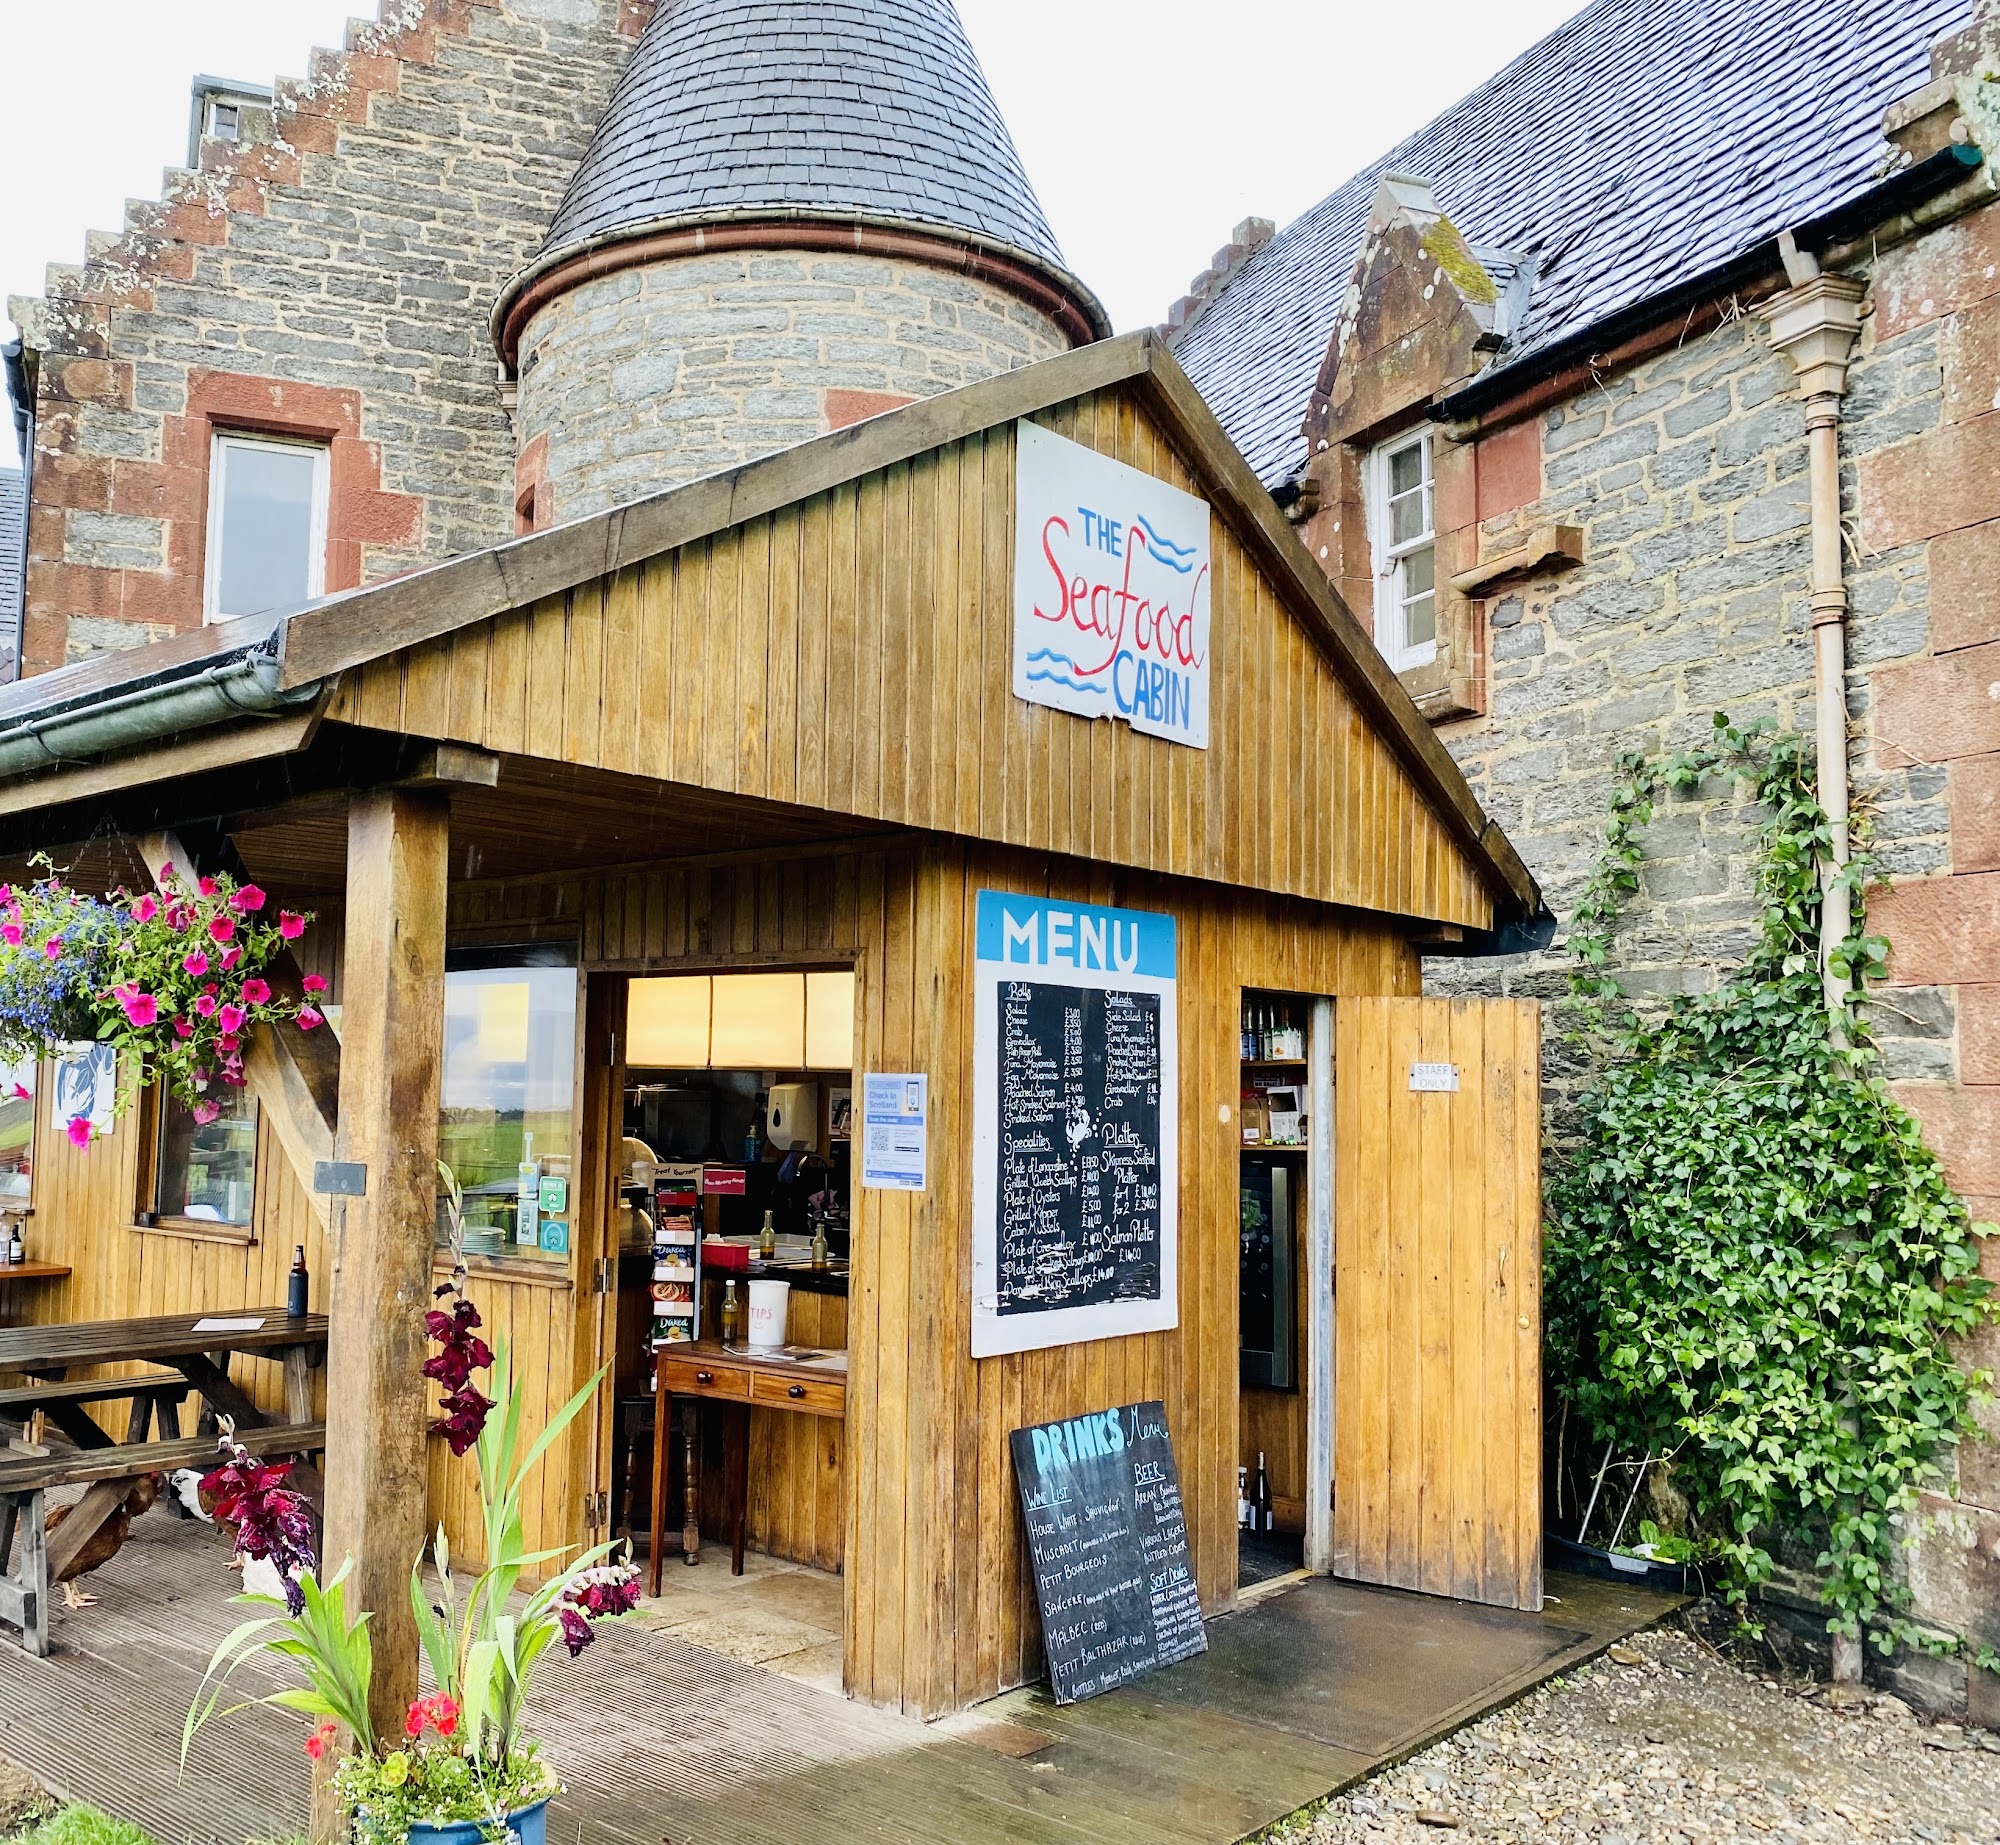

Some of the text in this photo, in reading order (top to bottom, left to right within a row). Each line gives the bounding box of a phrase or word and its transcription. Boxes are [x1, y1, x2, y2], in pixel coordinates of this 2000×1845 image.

[1078, 506, 1122, 557] THE
[1034, 516, 1208, 675] Seafood
[1113, 650, 1190, 730] CABIN
[1003, 908, 1138, 973] MENU
[1008, 982, 1031, 1001] Rolls
[1104, 990, 1133, 1008] Salads
[1005, 1003, 1028, 1016] Salad
[1105, 1010, 1121, 1022] Side
[1122, 1009, 1141, 1022] Salad
[1005, 1016, 1028, 1027] Cheese
[1005, 1025, 1023, 1037] Crab
[1106, 1022, 1129, 1032] Cheese
[1105, 1031, 1121, 1042] Tuna
[1003, 1057, 1021, 1071] Tuna
[1106, 1055, 1128, 1071] Smoked
[1128, 1055, 1146, 1069] Salmon
[1418, 1065, 1448, 1074] STAFF
[1003, 1069, 1020, 1090] Egg
[1420, 1078, 1446, 1088] ONLY
[1004, 1084, 1034, 1102] Poached
[1033, 1084, 1056, 1098] Salmon
[1104, 1094, 1124, 1109] Crab
[870, 1101, 897, 1109] Scotland
[1003, 1112, 1032, 1129] Smoked
[1031, 1109, 1054, 1122] Salmon
[1102, 1121, 1139, 1149] Platters
[1004, 1157, 1026, 1176] Plate
[1027, 1157, 1036, 1181] of
[1115, 1166, 1140, 1185] Platter
[1004, 1173, 1029, 1192] Grilled
[1054, 1170, 1078, 1196] Scallops
[1004, 1189, 1026, 1209] Plate
[1027, 1188, 1036, 1209] of
[1036, 1186, 1061, 1213] Oysters
[1112, 1186, 1124, 1206] for
[1004, 1204, 1032, 1226] Grilled
[1034, 1204, 1059, 1228] Kipper
[1112, 1202, 1124, 1223] for
[1123, 1202, 1131, 1216] 2
[1003, 1222, 1027, 1242] Cabin
[1027, 1217, 1060, 1235] Mussels
[1101, 1225, 1133, 1252] Salmon
[1130, 1218, 1155, 1242] Platter
[1003, 1239, 1027, 1260] Plate
[1027, 1238, 1037, 1261] of
[1003, 1260, 1027, 1280] Plate
[1027, 1260, 1036, 1276] of
[1060, 1268, 1092, 1294] Scallops
[750, 1307, 772, 1319] TIPS
[1031, 1405, 1168, 1473] DRINKS Menu
[1134, 1461, 1165, 1484] BEER
[1024, 1481, 1069, 1508] WINE LIST
[1030, 1520, 1055, 1541] HOUSE
[1085, 1497, 1119, 1521] SAUVIGNON
[1162, 1522, 1185, 1542] LAGERS
[1034, 1539, 1078, 1565] MUSCADET
[1144, 1540, 1187, 1566] BOTTLED CIDER
[1040, 1554, 1107, 1590] PETIT BOURGEOIS
[1150, 1571, 1168, 1591] SOFT
[1048, 1621, 1088, 1650] MALBEC
[1053, 1658, 1079, 1680] PETIT
[1081, 1636, 1128, 1667] BALTHAZAR
[1072, 1679, 1096, 1698] BOTTLES
